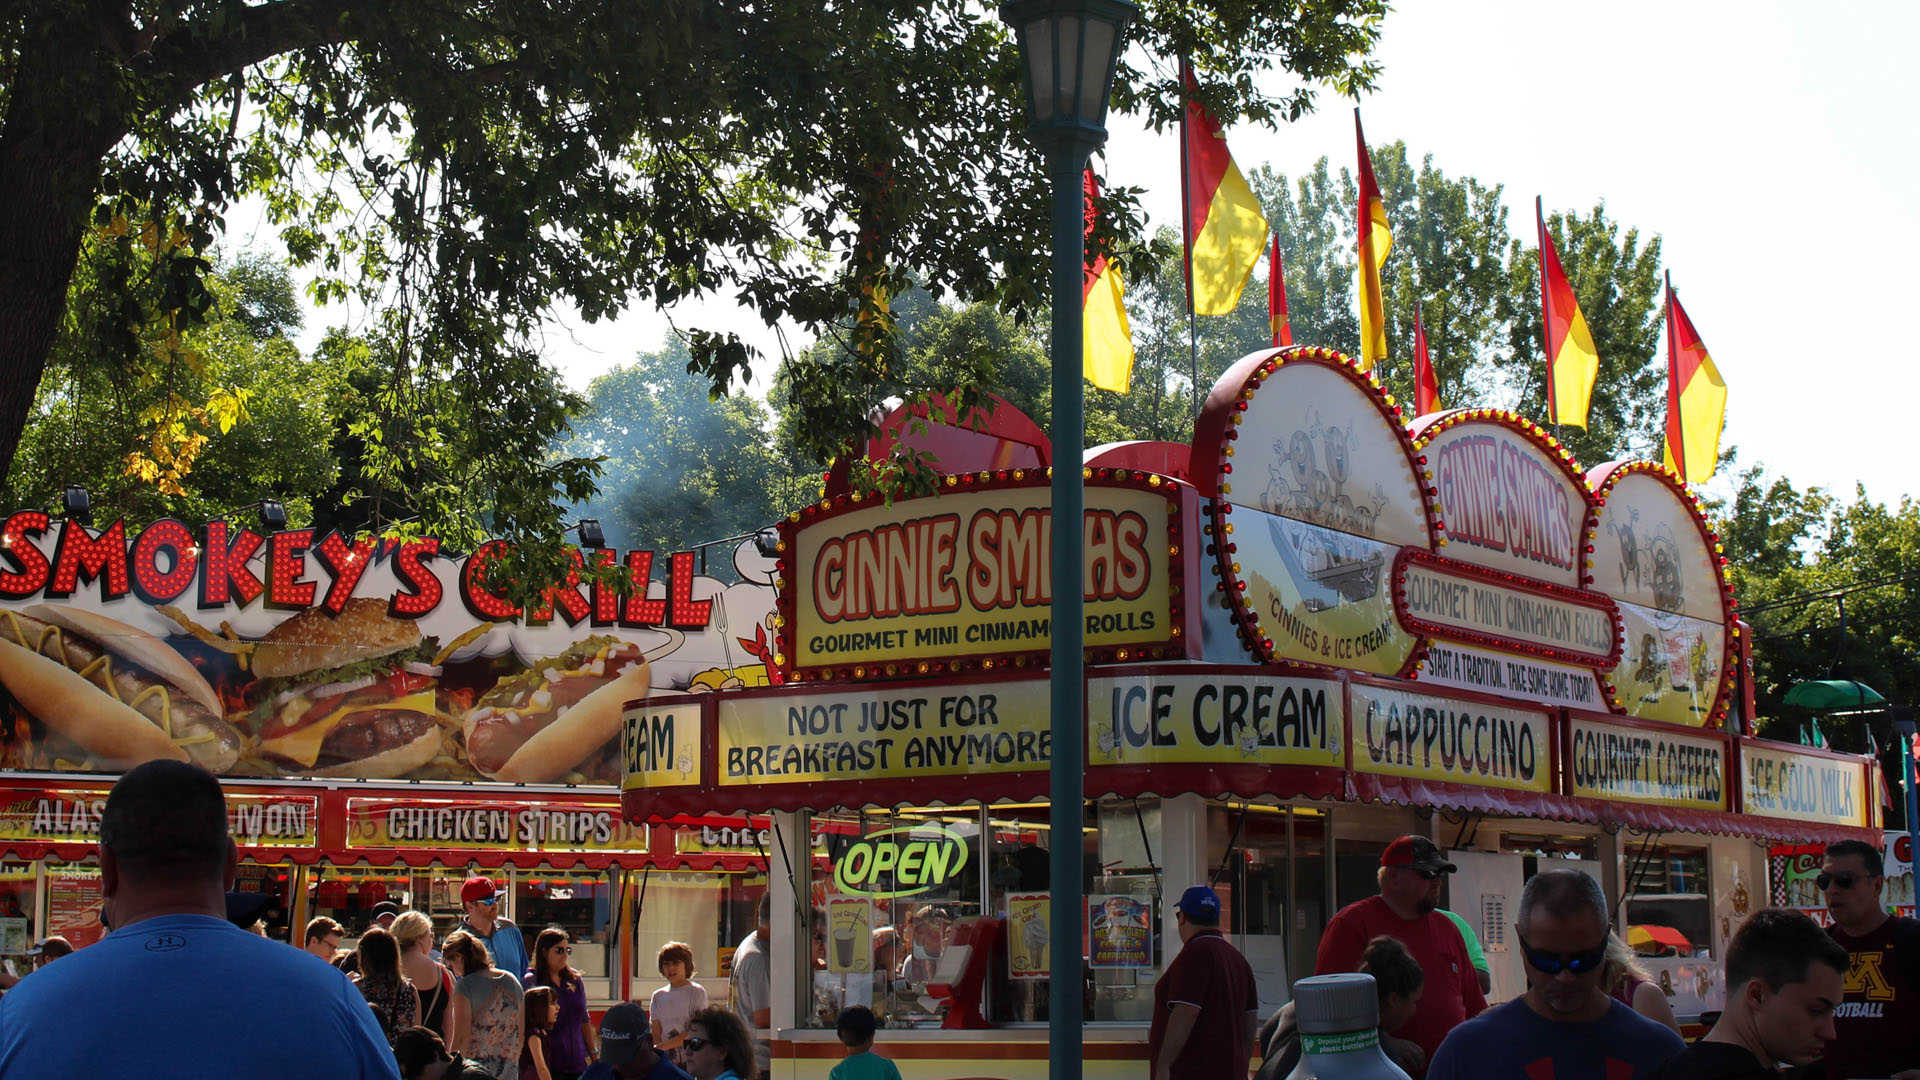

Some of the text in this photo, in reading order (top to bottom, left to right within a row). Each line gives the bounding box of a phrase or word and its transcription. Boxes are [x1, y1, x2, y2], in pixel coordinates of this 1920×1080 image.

[1438, 435, 1573, 571] CINNIE SMITHS
[813, 508, 1151, 623] CINNIE SMIHS
[809, 611, 1155, 654] GOURMET MINI CINNAM ROLLS
[1403, 572, 1611, 651] GOURMET MINI CINNAMON ROLLS
[1321, 635, 1331, 657] &
[1335, 638, 1352, 659] ICE
[1428, 648, 1452, 680] START
[1454, 654, 1461, 681] A
[1507, 662, 1526, 693] TAKE
[1528, 666, 1548, 697] SOME
[1549, 671, 1569, 699] HOME
[1570, 674, 1594, 703] TODAY!
[788, 694, 999, 737] NOT JUST FOR
[1111, 684, 1327, 748] ICE CREAM
[728, 730, 1051, 776] BREAKFAST ANYMORE
[1367, 700, 1536, 782] CAPPUCCINO
[1573, 728, 1721, 802] GOURMET COFFEES
[1751, 757, 1854, 818] ICE COLD MILK
[32, 799, 105, 834] ALAS
[388, 807, 509, 843] CHICKEN
[519, 809, 612, 844] STRIPS
[60, 870, 102, 882] SMOKEY
[843, 842, 953, 885] OPEN
